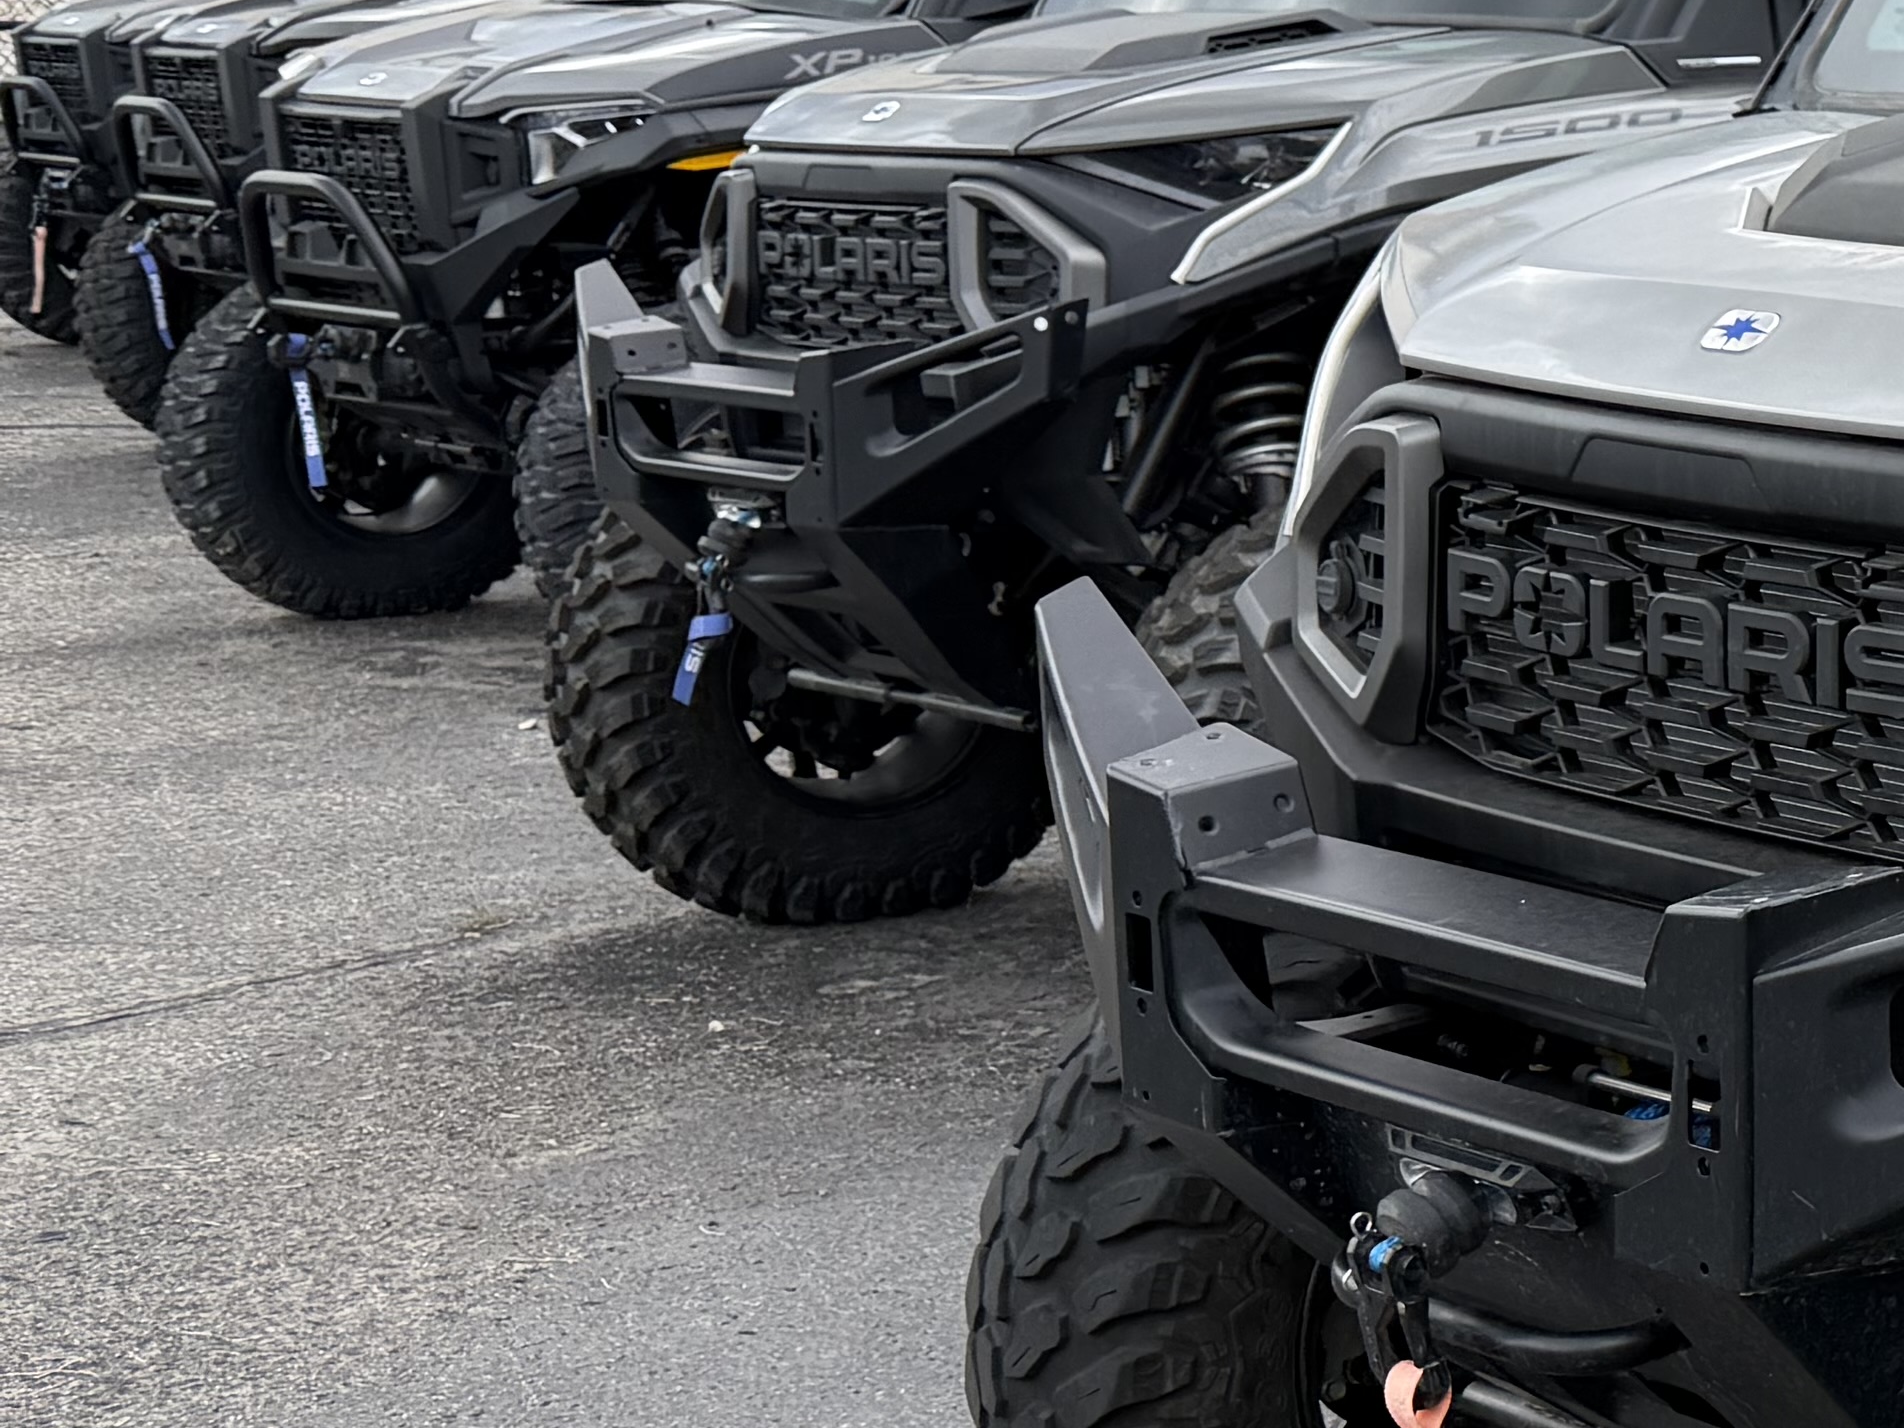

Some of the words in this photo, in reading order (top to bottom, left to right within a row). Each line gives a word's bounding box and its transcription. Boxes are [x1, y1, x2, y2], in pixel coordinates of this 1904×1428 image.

[783, 48, 864, 80] XP
[1475, 107, 1683, 148] 1500
[756, 230, 948, 287] POLARIS
